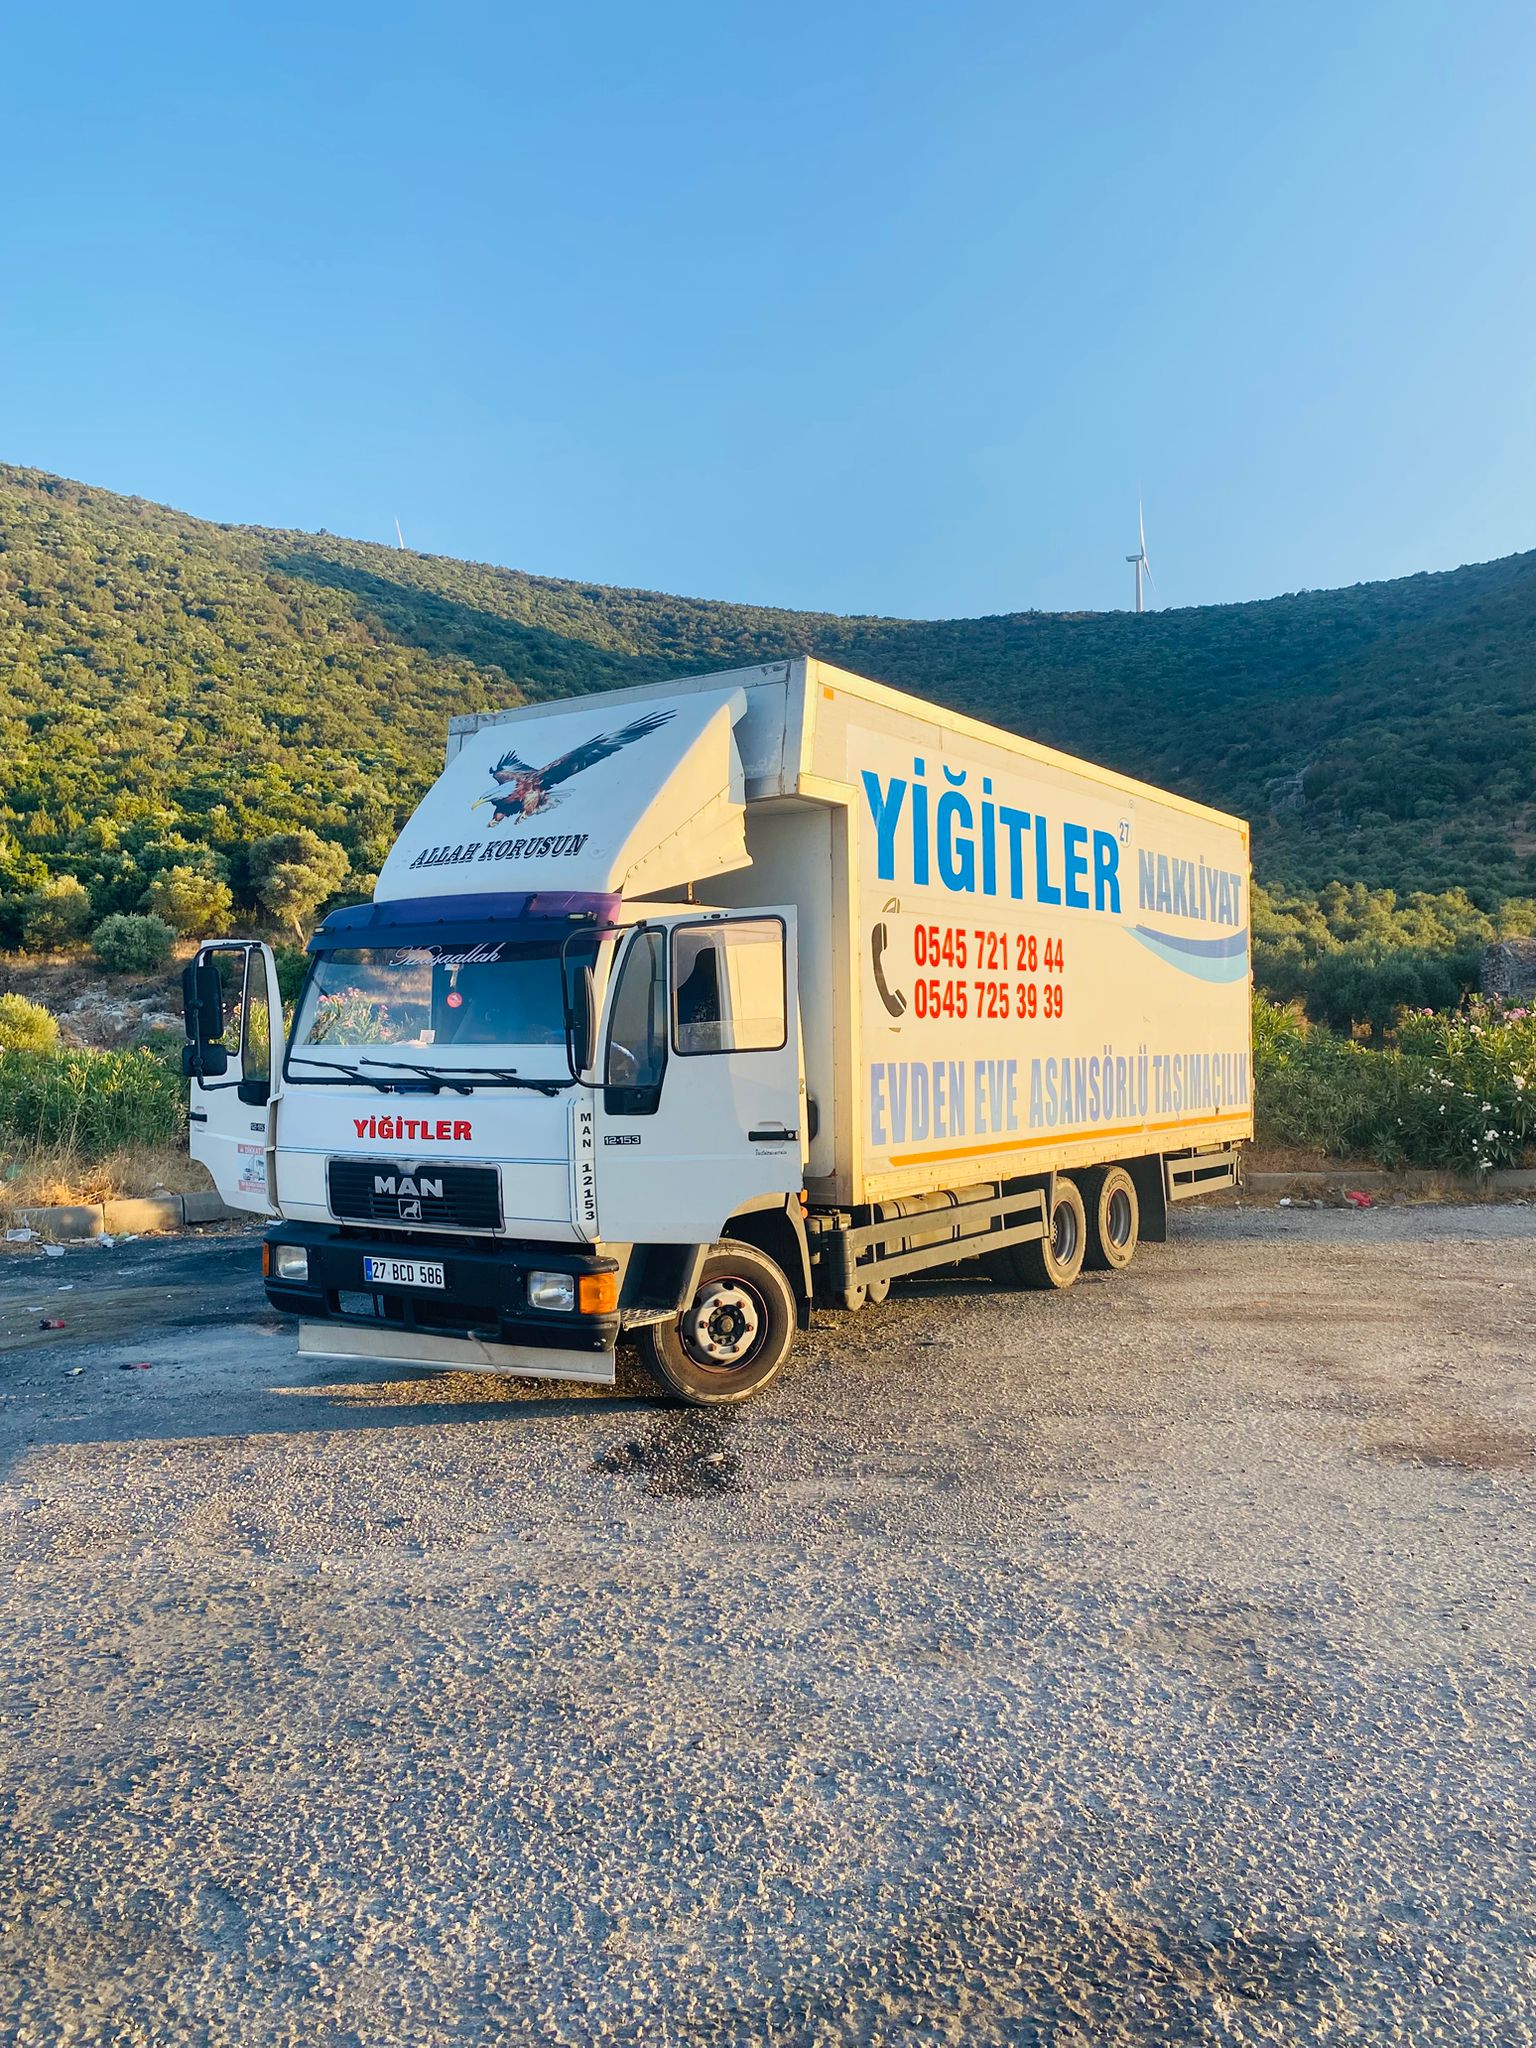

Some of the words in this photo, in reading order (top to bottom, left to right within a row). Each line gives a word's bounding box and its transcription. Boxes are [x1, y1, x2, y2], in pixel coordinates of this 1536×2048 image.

[409, 842, 481, 869] ALLAH
[478, 834, 589, 862] KORUSUN
[861, 757, 1121, 913] YİĞİTLER
[1119, 822, 1130, 843] 27
[1138, 848, 1241, 926] NAKLİYAT
[914, 924, 967, 969] 0545
[974, 931, 1008, 970] 721
[1016, 934, 1038, 972] 28
[1044, 937, 1064, 973] 44
[914, 978, 967, 1019] 0545
[974, 981, 1009, 1019] 725
[1016, 983, 1037, 1019] 39
[1043, 984, 1064, 1018] 39
[871, 1061, 965, 1146] EVDEN
[975, 1059, 1018, 1134] EVE
[1029, 1044, 1148, 1128] ASANSÖRLÜ
[1153, 1053, 1247, 1121] TAŞIMACILIK
[353, 1115, 472, 1140] YİĞİTLER
[580, 1113, 592, 1148] MAN
[374, 1176, 443, 1198] MAN
[582, 1163, 595, 1220] 12153
[373, 1261, 386, 1278] 27
[392, 1263, 414, 1281] BCD
[420, 1266, 442, 1284] 586
